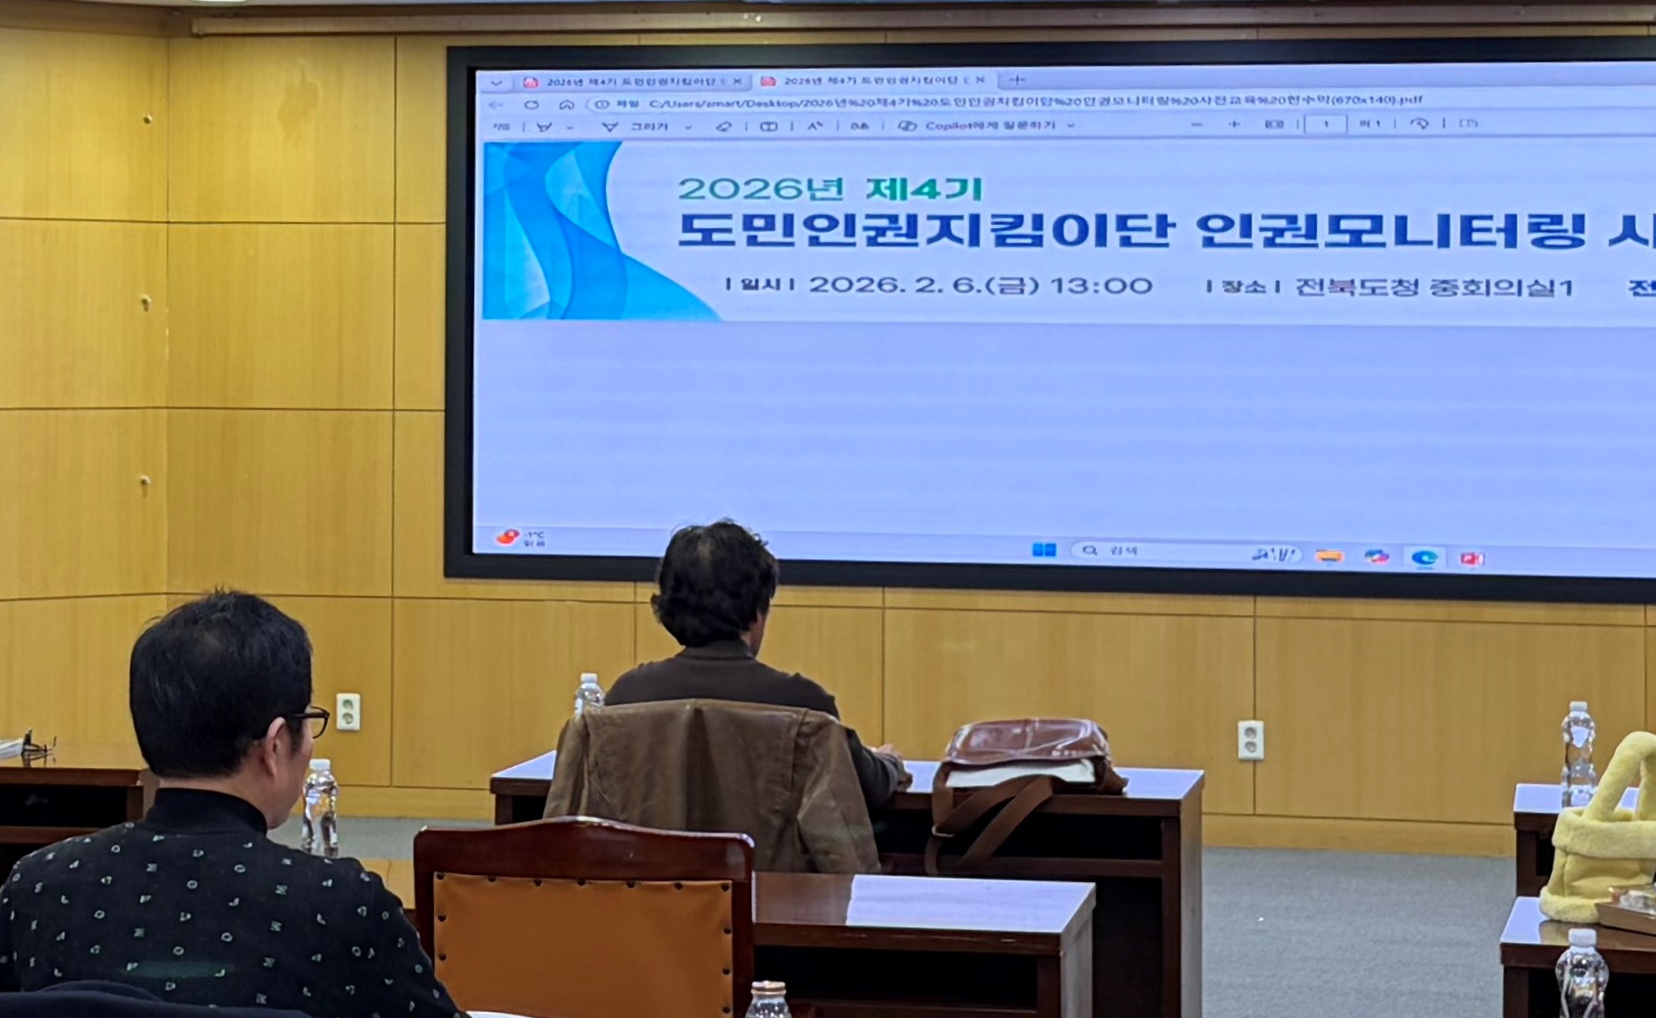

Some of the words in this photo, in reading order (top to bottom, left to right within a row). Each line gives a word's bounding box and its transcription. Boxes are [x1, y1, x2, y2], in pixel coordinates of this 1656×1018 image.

[678, 177, 844, 202] 2026년
[865, 177, 982, 202] 제4기
[678, 212, 1177, 249] 도민인권지킴이단
[1196, 213, 1586, 250] 인권모니터링
[809, 276, 906, 293] 2026.
[1050, 277, 1154, 295] 13:00
[1296, 277, 1420, 298] 전북도청
[1429, 278, 1573, 298] 중회의실1
